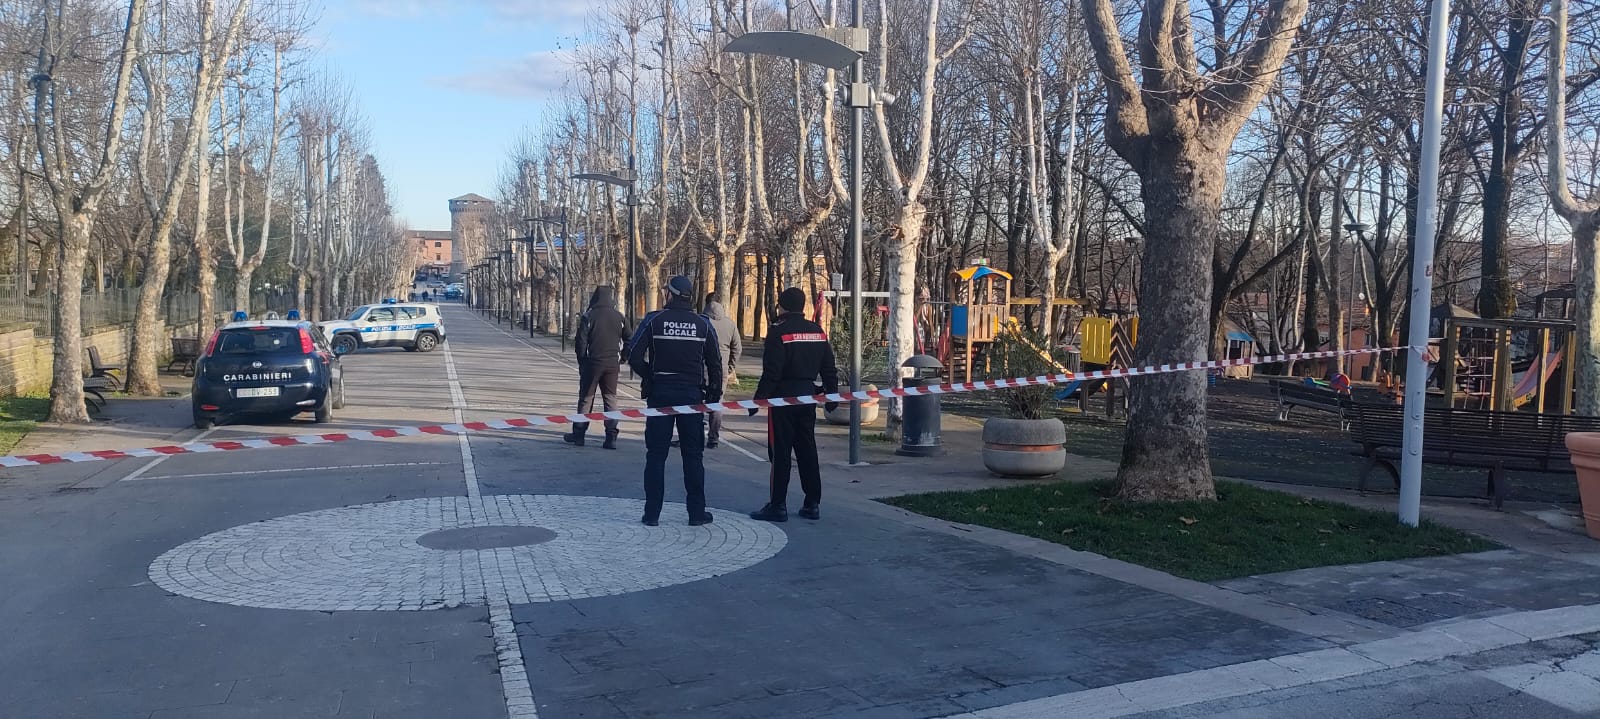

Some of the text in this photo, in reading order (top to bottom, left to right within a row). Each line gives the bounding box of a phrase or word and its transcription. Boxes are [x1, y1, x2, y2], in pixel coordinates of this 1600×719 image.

[664, 321, 696, 330] POLIZIA
[664, 329, 697, 337] LOCALE
[223, 372, 292, 381] CARABINIERI
